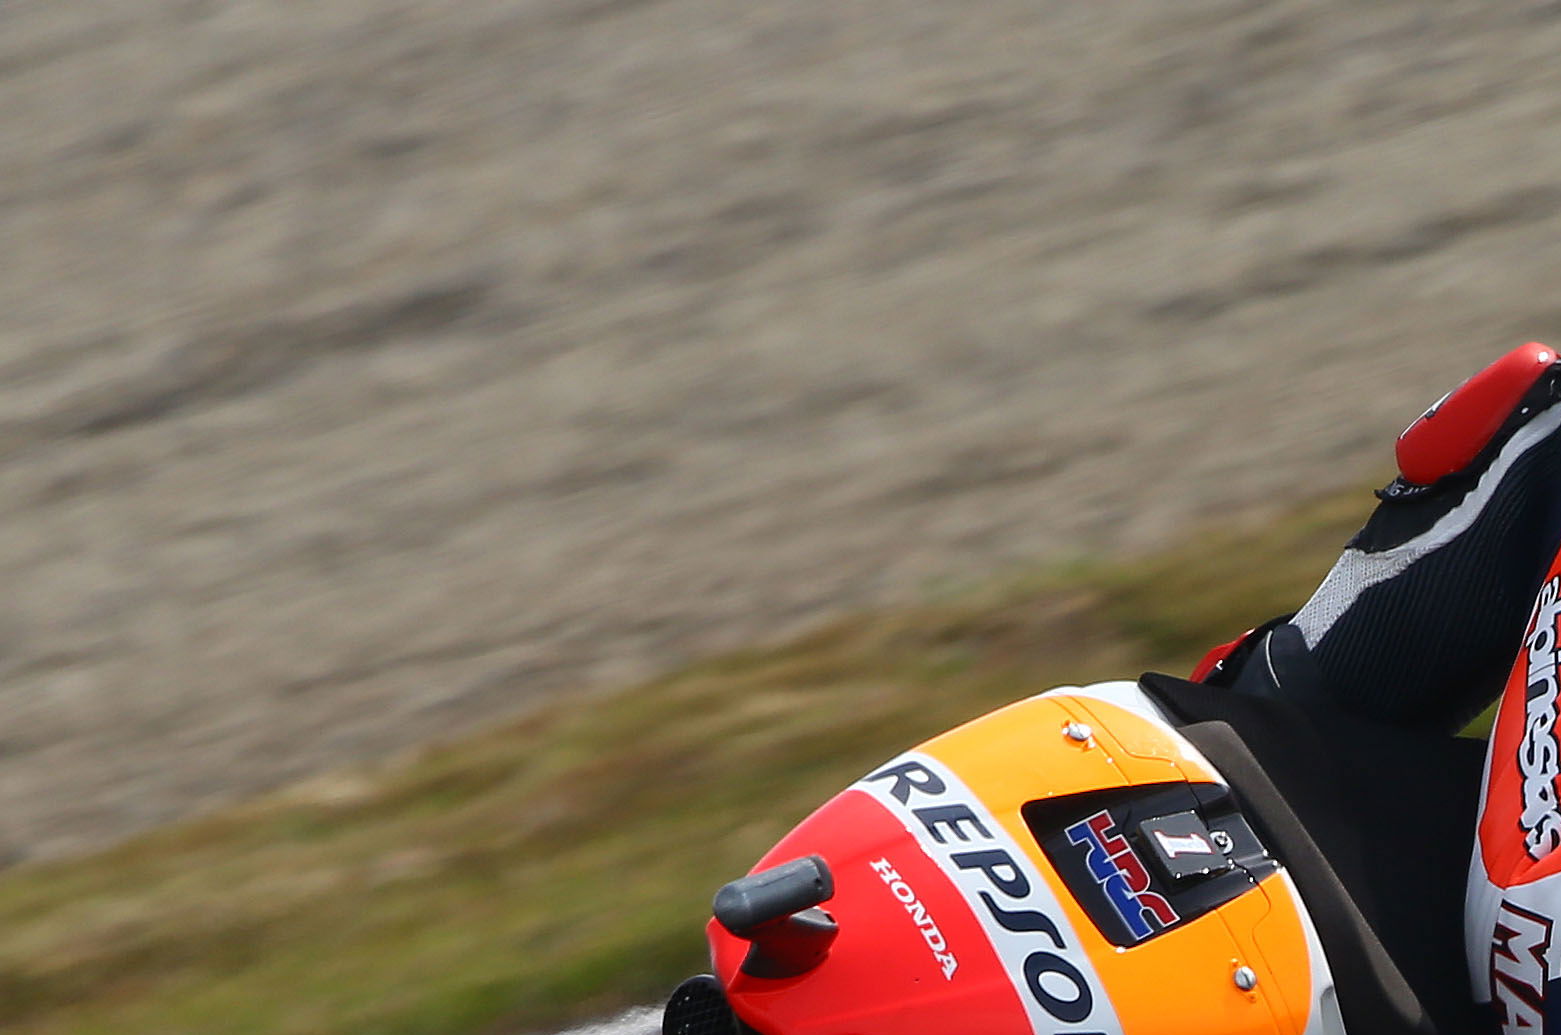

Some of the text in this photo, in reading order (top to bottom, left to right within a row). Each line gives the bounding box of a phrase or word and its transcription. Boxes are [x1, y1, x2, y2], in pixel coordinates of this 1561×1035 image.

[1065, 810, 1180, 940] HRC
[1153, 830, 1215, 859] 1
[870, 857, 959, 981] HONDA
